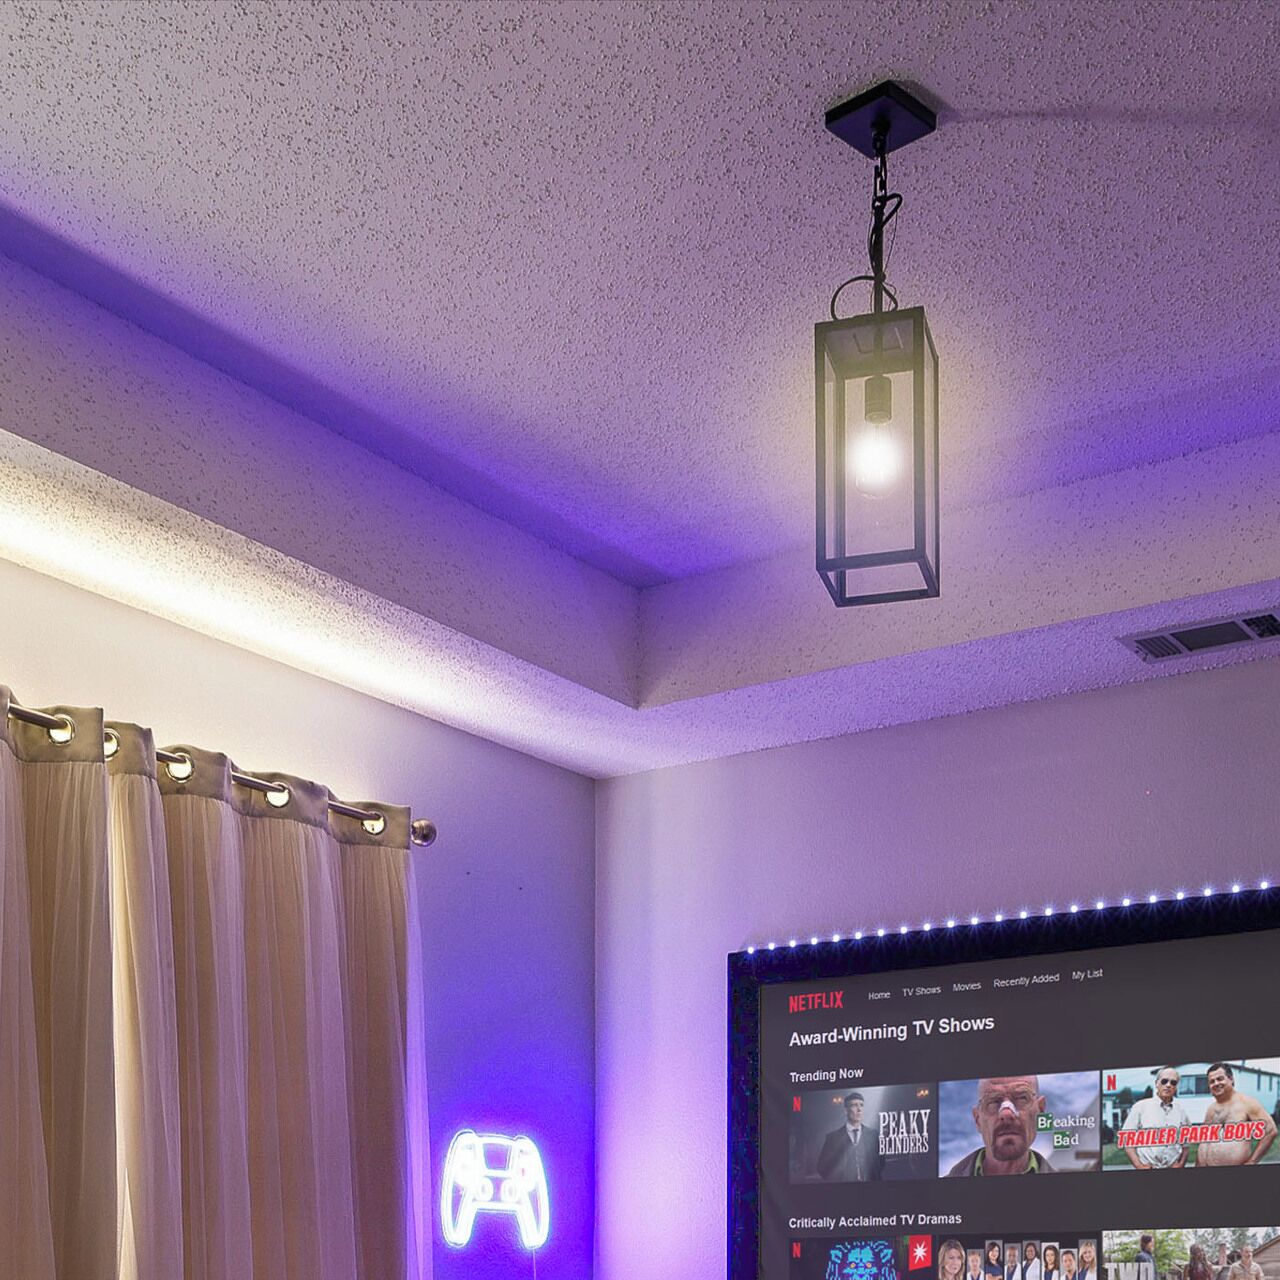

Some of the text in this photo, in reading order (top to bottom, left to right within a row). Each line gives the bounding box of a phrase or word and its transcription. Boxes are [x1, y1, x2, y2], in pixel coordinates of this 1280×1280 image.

[789, 967, 1103, 1013] NETFLIX Home TV Shows Movies Recently Added My List
[789, 1015, 995, 1047] Award-Winning TV Shows
[790, 1066, 864, 1083] Trending Now
[879, 1109, 930, 1137] PEAKY
[1037, 1114, 1095, 1130] Breaking
[879, 1134, 929, 1155] BLINDERS
[1054, 1132, 1079, 1146] Bad
[1117, 1120, 1266, 1148] TRAILER PARK BOYS
[788, 1213, 962, 1230] Critically Acclaimed TV Dramas
